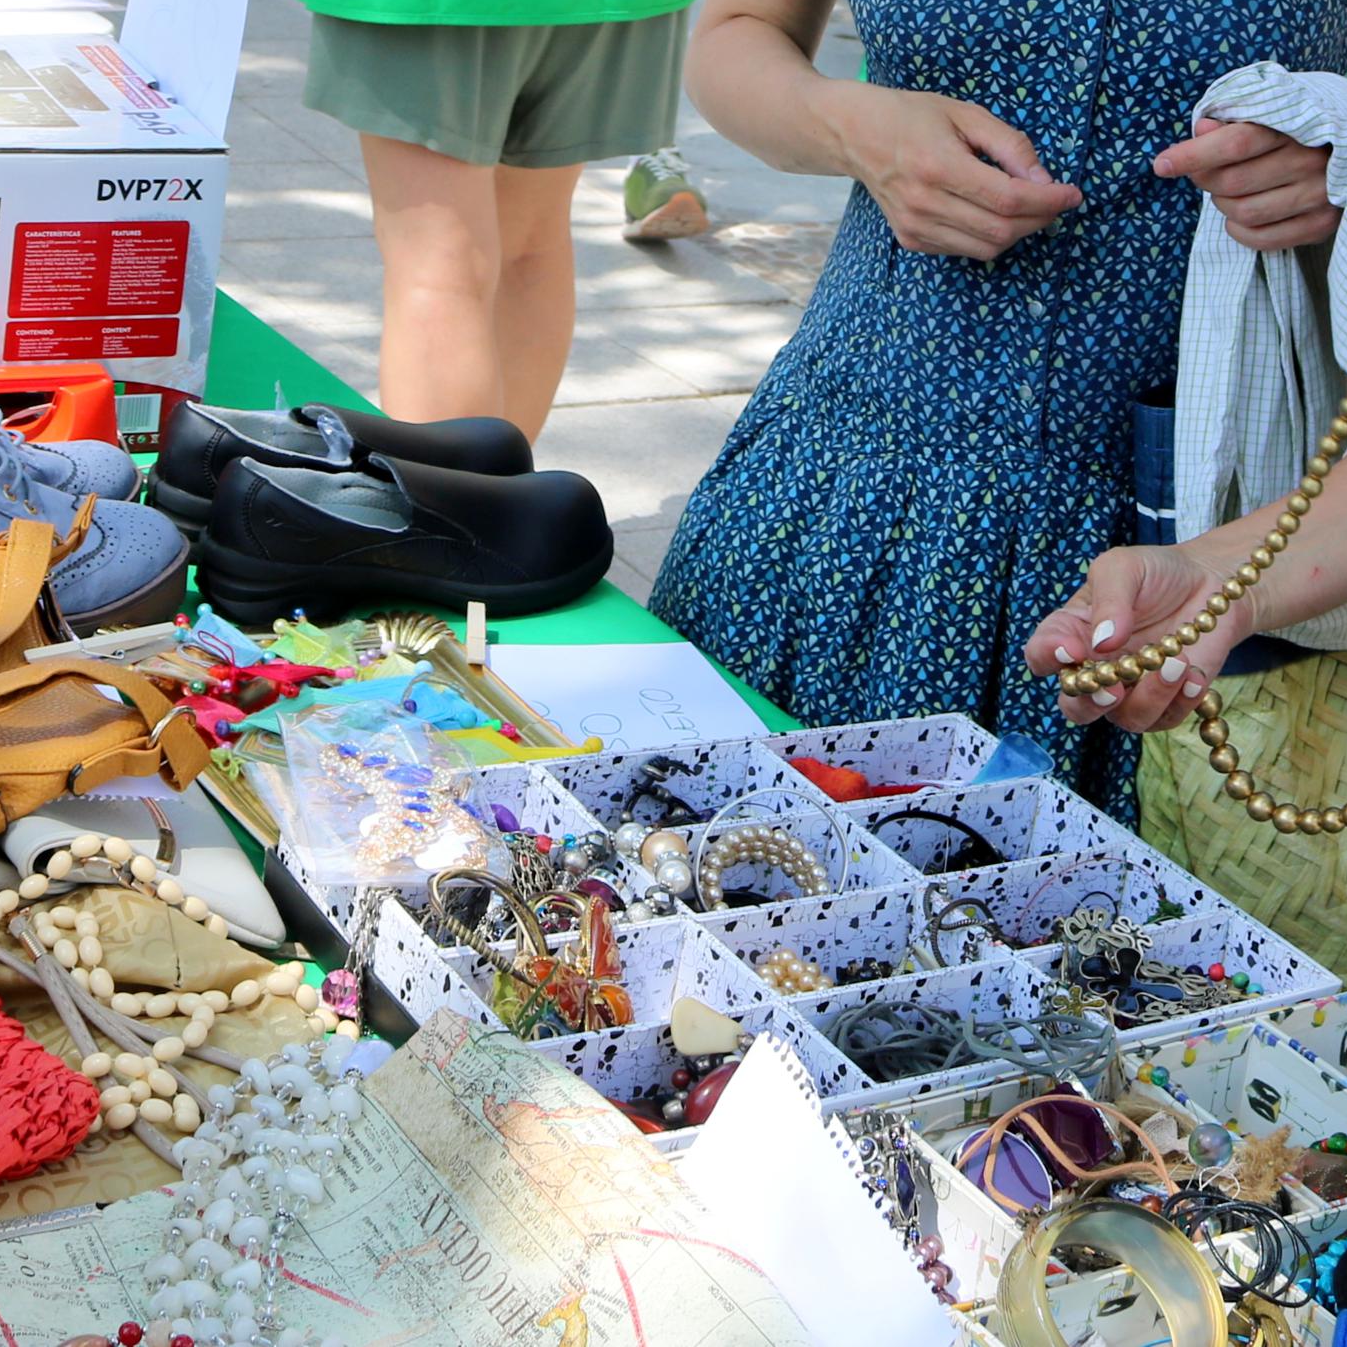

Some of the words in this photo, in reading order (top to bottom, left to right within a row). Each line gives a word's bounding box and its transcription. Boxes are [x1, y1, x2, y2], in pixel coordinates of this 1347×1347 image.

[96, 178, 204, 201] DVP72X
[24, 229, 82, 238] CARACTERÍSTICAS
[111, 229, 142, 238] FEATURES
[15, 328, 55, 337] CONTENIDO
[101, 326, 133, 335] CONTENT
[513, 1193, 562, 1249] NAUTICAL
[408, 1188, 498, 1286] OCEAN
